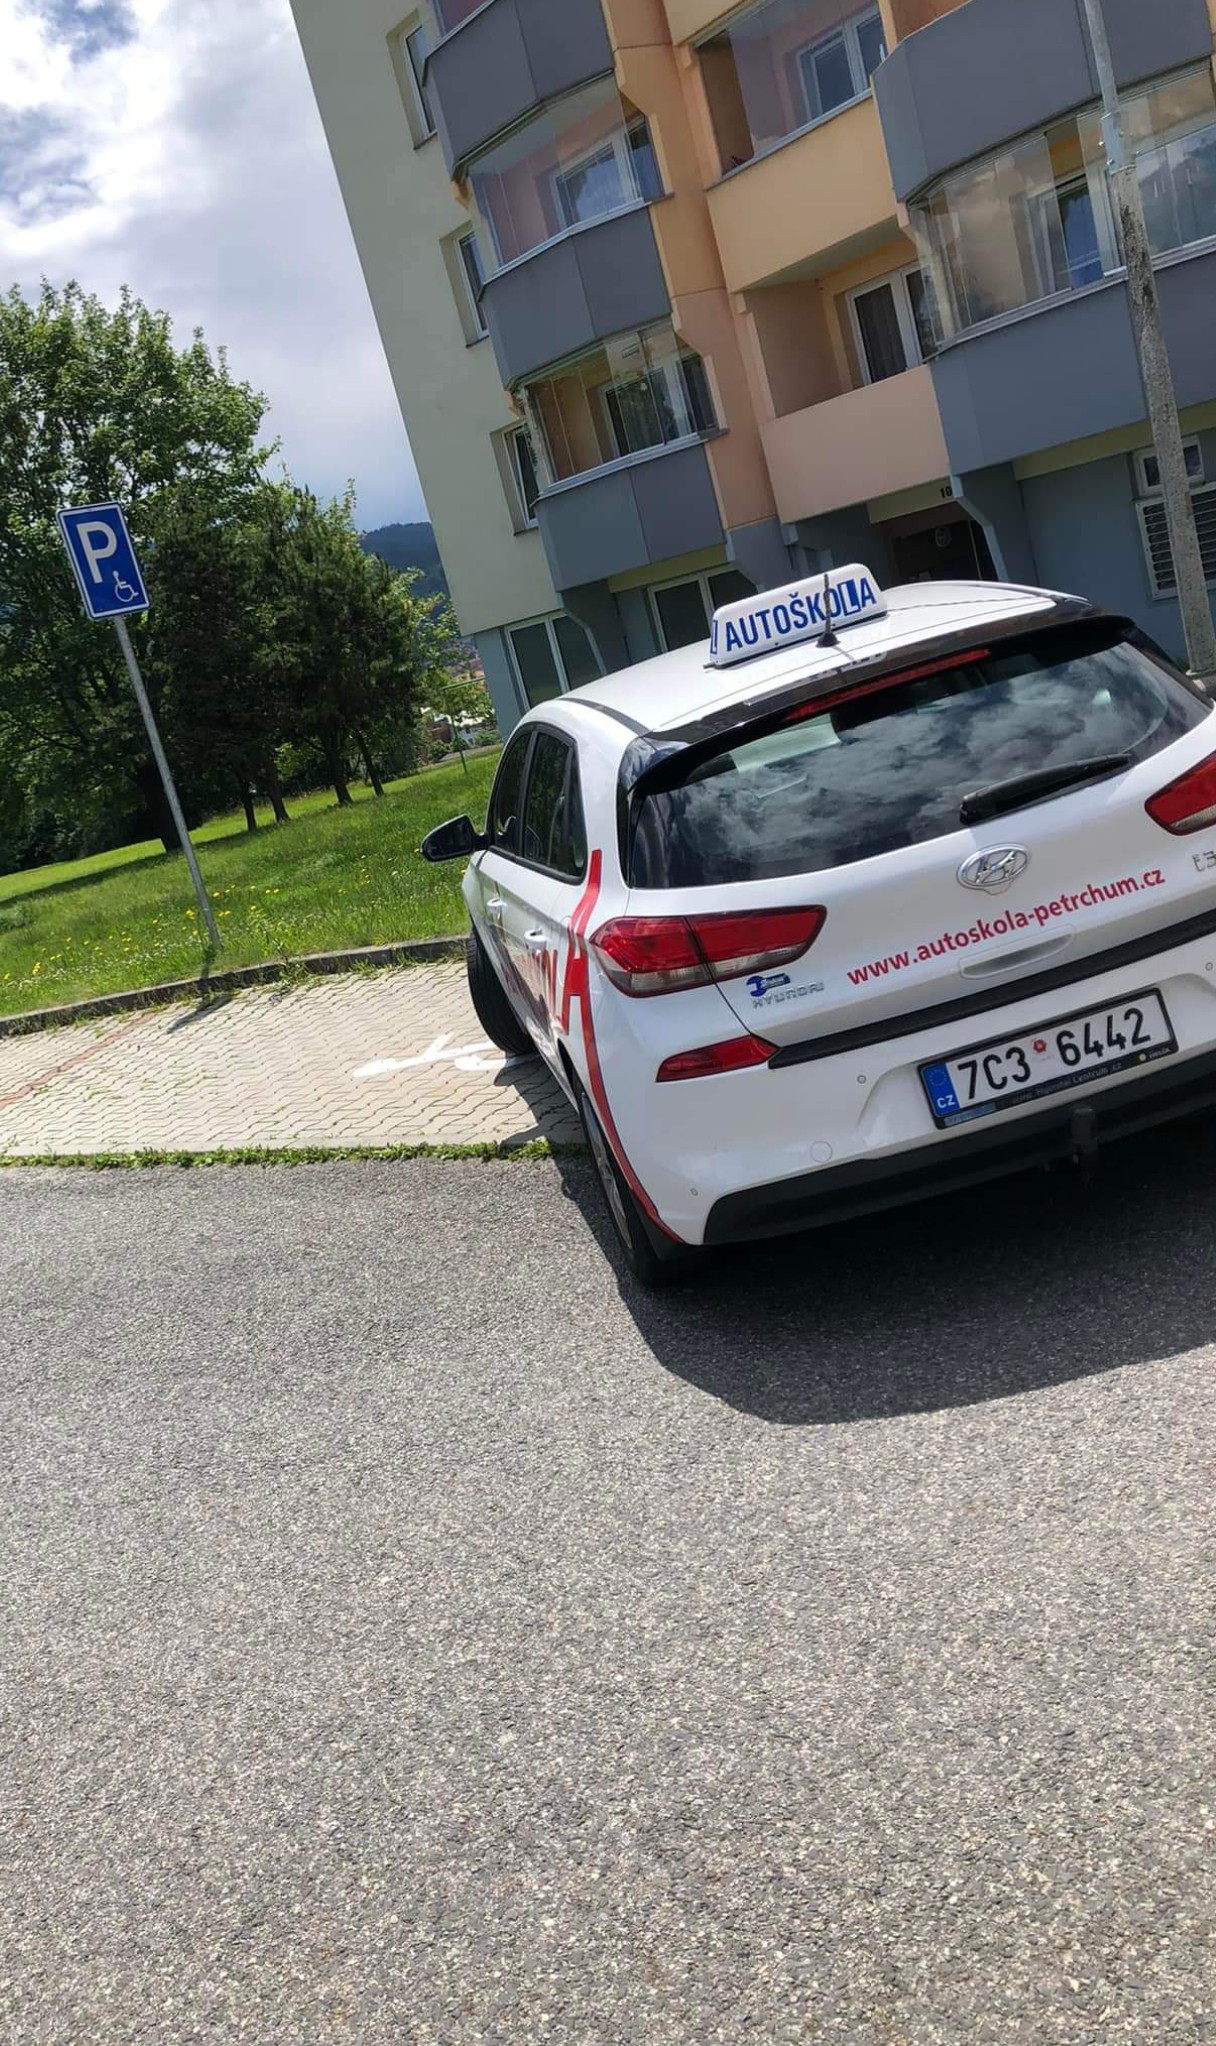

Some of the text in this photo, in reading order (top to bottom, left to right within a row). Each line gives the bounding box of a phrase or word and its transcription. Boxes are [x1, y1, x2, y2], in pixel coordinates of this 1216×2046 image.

[940, 486, 953, 498] 10
[76, 521, 117, 584] P
[725, 577, 877, 651] AUTOŠKOLA
[847, 868, 1165, 985] www.autoskola-petrchum.cz
[752, 981, 824, 1008] HYUNDAI
[957, 1047, 1031, 1100] 7C3
[1056, 1007, 1151, 1066] 6442
[937, 1094, 956, 1109] CZ
